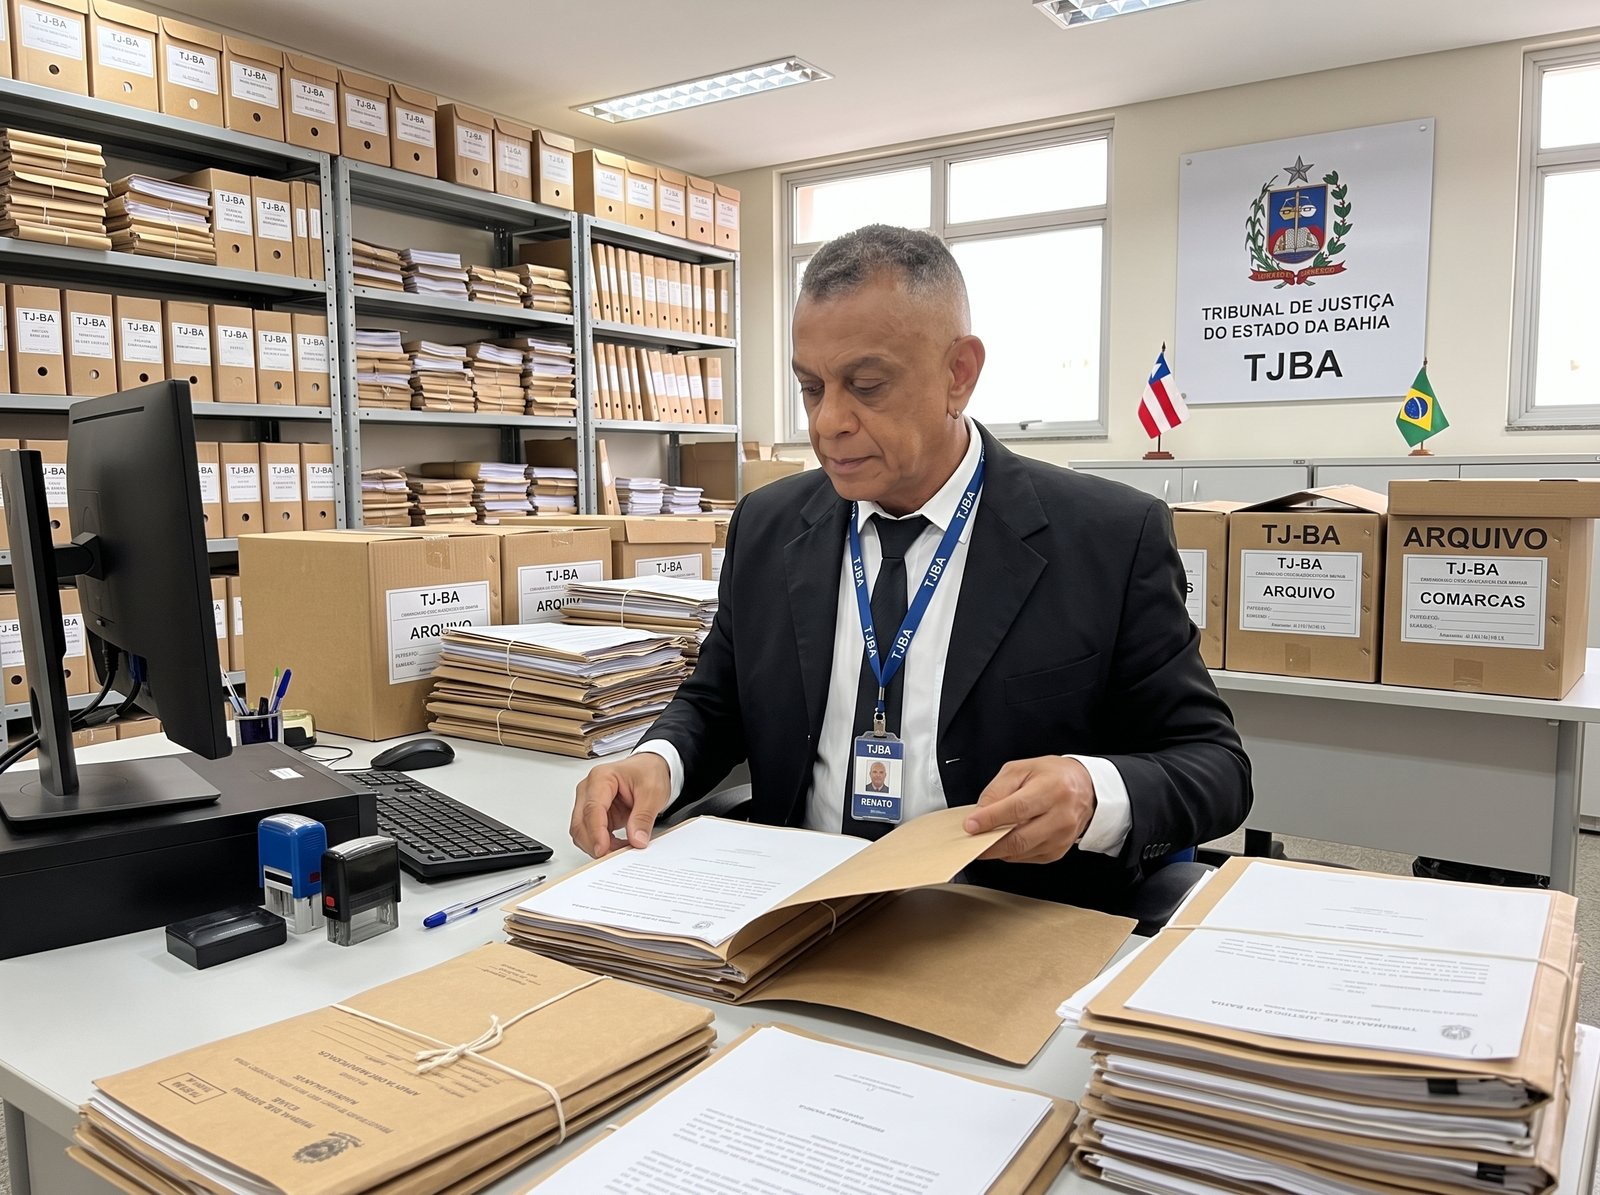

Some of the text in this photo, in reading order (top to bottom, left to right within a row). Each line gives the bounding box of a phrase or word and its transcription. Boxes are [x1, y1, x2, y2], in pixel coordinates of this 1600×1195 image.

[36, 13, 67, 29] TJ-BA
[112, 33, 139, 48] TJ-BA
[179, 51, 205, 66] TJ-BA
[242, 68, 267, 81] TJ-BA
[302, 85, 325, 98] TJ-BA
[356, 99, 377, 111] TJ-BA
[405, 113, 425, 125] TJ-BA
[220, 194, 245, 206] TJ-BA
[261, 201, 286, 213] TJ-BA
[1202, 293, 1395, 321] TRIBUNAL DE JUSTIÇA
[22, 312, 55, 323] TJ-BA
[76, 317, 106, 328] TJ-BA
[127, 322, 156, 333] TJ-BA
[177, 326, 205, 337] TJ-BA
[223, 329, 248, 339] TJ-BA
[1204, 315, 1390, 340] DO ESTADO DA BAHIA
[263, 334, 287, 344] TJ-BA
[301, 337, 325, 346] TJ-BA
[1244, 349, 1343, 382] TJBA
[44, 467, 66, 475] J-BA
[956, 490, 976, 521] TJBA
[1262, 524, 1341, 545] TJ-BA
[1403, 526, 1548, 550] ARQUIVO
[656, 561, 683, 573] TJ-BA
[1277, 557, 1323, 570] TJ-BA
[1446, 562, 1499, 576] TJ-BA
[546, 569, 579, 582] TJ-BA
[853, 556, 864, 588] TJBA
[924, 556, 947, 588] TJBA
[420, 591, 460, 607] TJ-BA
[1262, 586, 1336, 600] ARQUIVO
[537, 598, 580, 612] ARQU
[1420, 592, 1526, 608] COMARCAS
[0, 623, 19, 633] J-B
[863, 625, 877, 658] TJBA
[891, 629, 913, 660] TJBA
[867, 744, 891, 755] TJBA
[861, 797, 893, 809] RENATO
